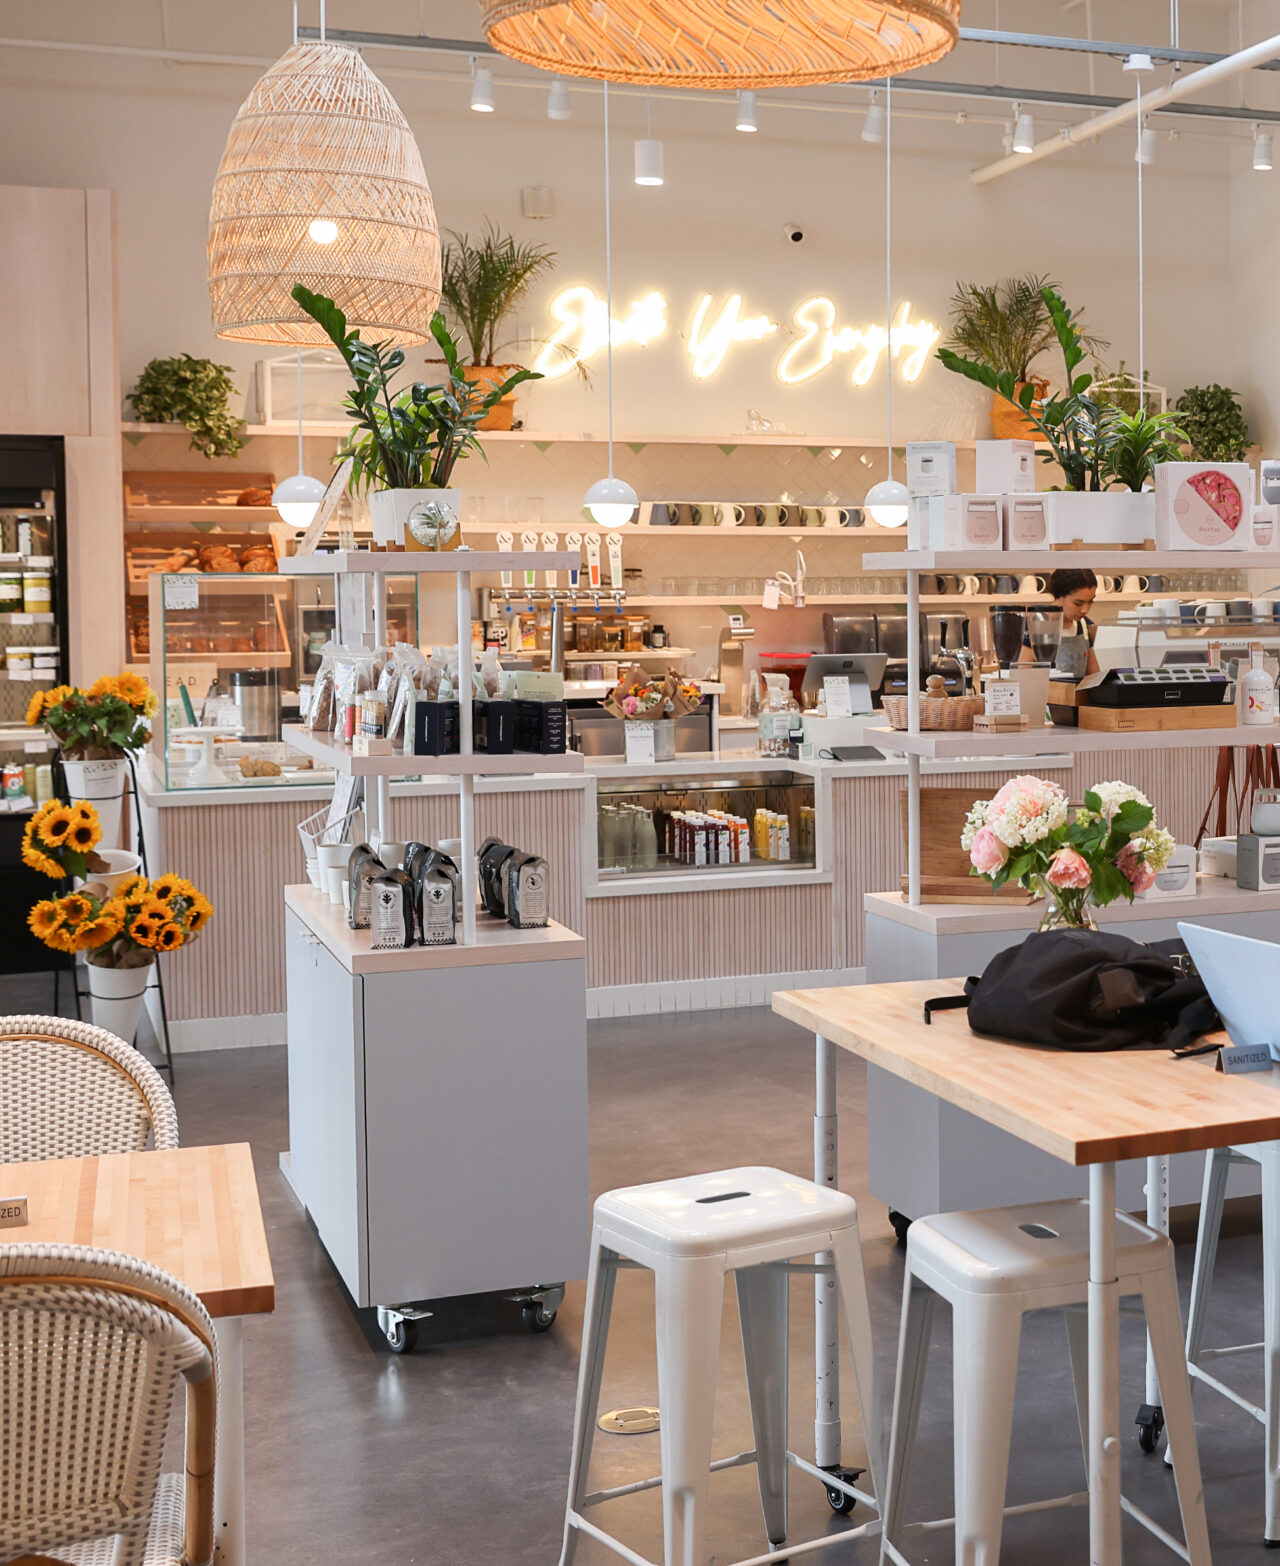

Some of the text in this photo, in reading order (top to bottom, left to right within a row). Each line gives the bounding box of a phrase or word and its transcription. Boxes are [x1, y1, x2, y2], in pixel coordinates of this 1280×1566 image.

[688, 293, 778, 379] Your
[778, 297, 940, 386] Everyday
[143, 676, 197, 687] BEAD
[1227, 1053, 1266, 1065] SANITIZED
[0, 1206, 21, 1219] ZED
